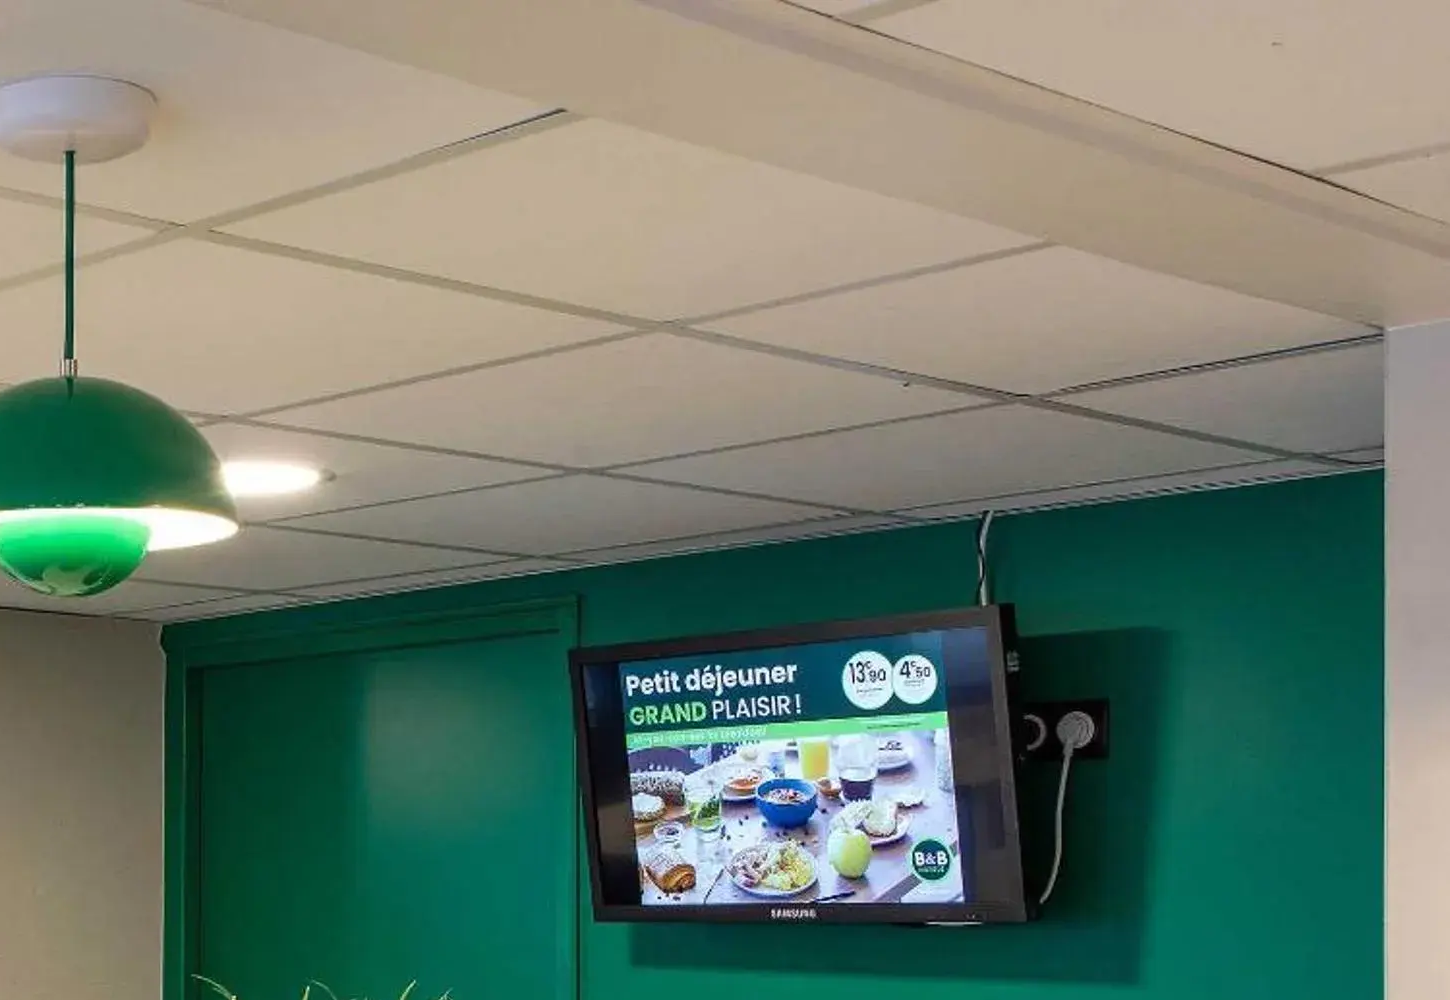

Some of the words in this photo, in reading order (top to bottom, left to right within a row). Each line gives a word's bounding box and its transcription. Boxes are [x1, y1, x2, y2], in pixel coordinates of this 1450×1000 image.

[625, 669, 681, 697] Petit
[684, 664, 798, 697] déjeuner
[629, 702, 707, 726] GRAND
[711, 695, 792, 721] PLAISIR
[914, 851, 948, 867] B&B
[770, 908, 817, 919] SAMSUNG
